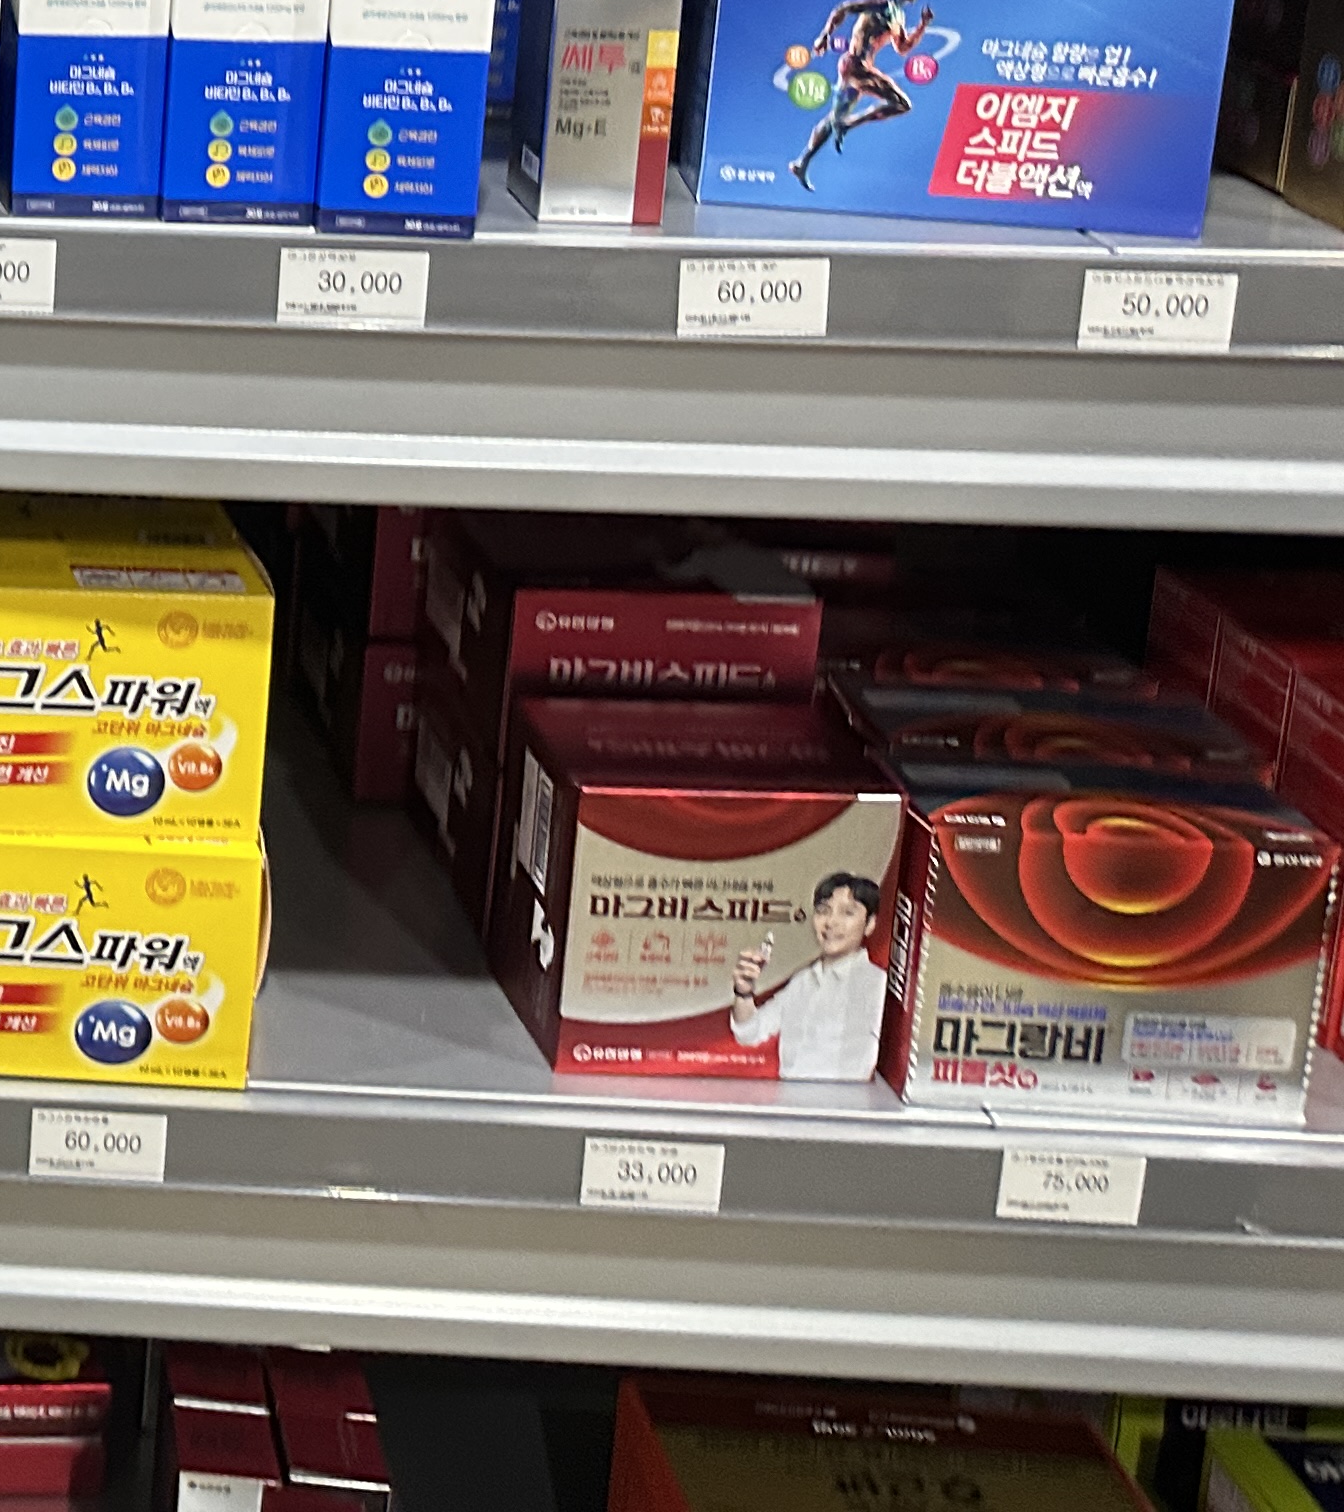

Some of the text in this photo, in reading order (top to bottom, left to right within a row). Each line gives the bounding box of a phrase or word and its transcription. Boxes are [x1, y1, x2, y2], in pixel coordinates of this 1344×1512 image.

[793, 75, 827, 104] Mg
[975, 92, 1080, 131] 이엠지
[963, 128, 1061, 163] 스피드
[317, 269, 403, 295] 30,000
[717, 279, 803, 305] 60,000
[1121, 291, 1210, 319] 50,000
[104, 676, 196, 719] 파워
[104, 768, 150, 798] Mg
[589, 894, 794, 925] 마그비스피드
[94, 930, 184, 973] 파워
[91, 1018, 138, 1048] Mg
[64, 1130, 143, 1155] 60,000
[617, 1158, 699, 1186] 33,000
